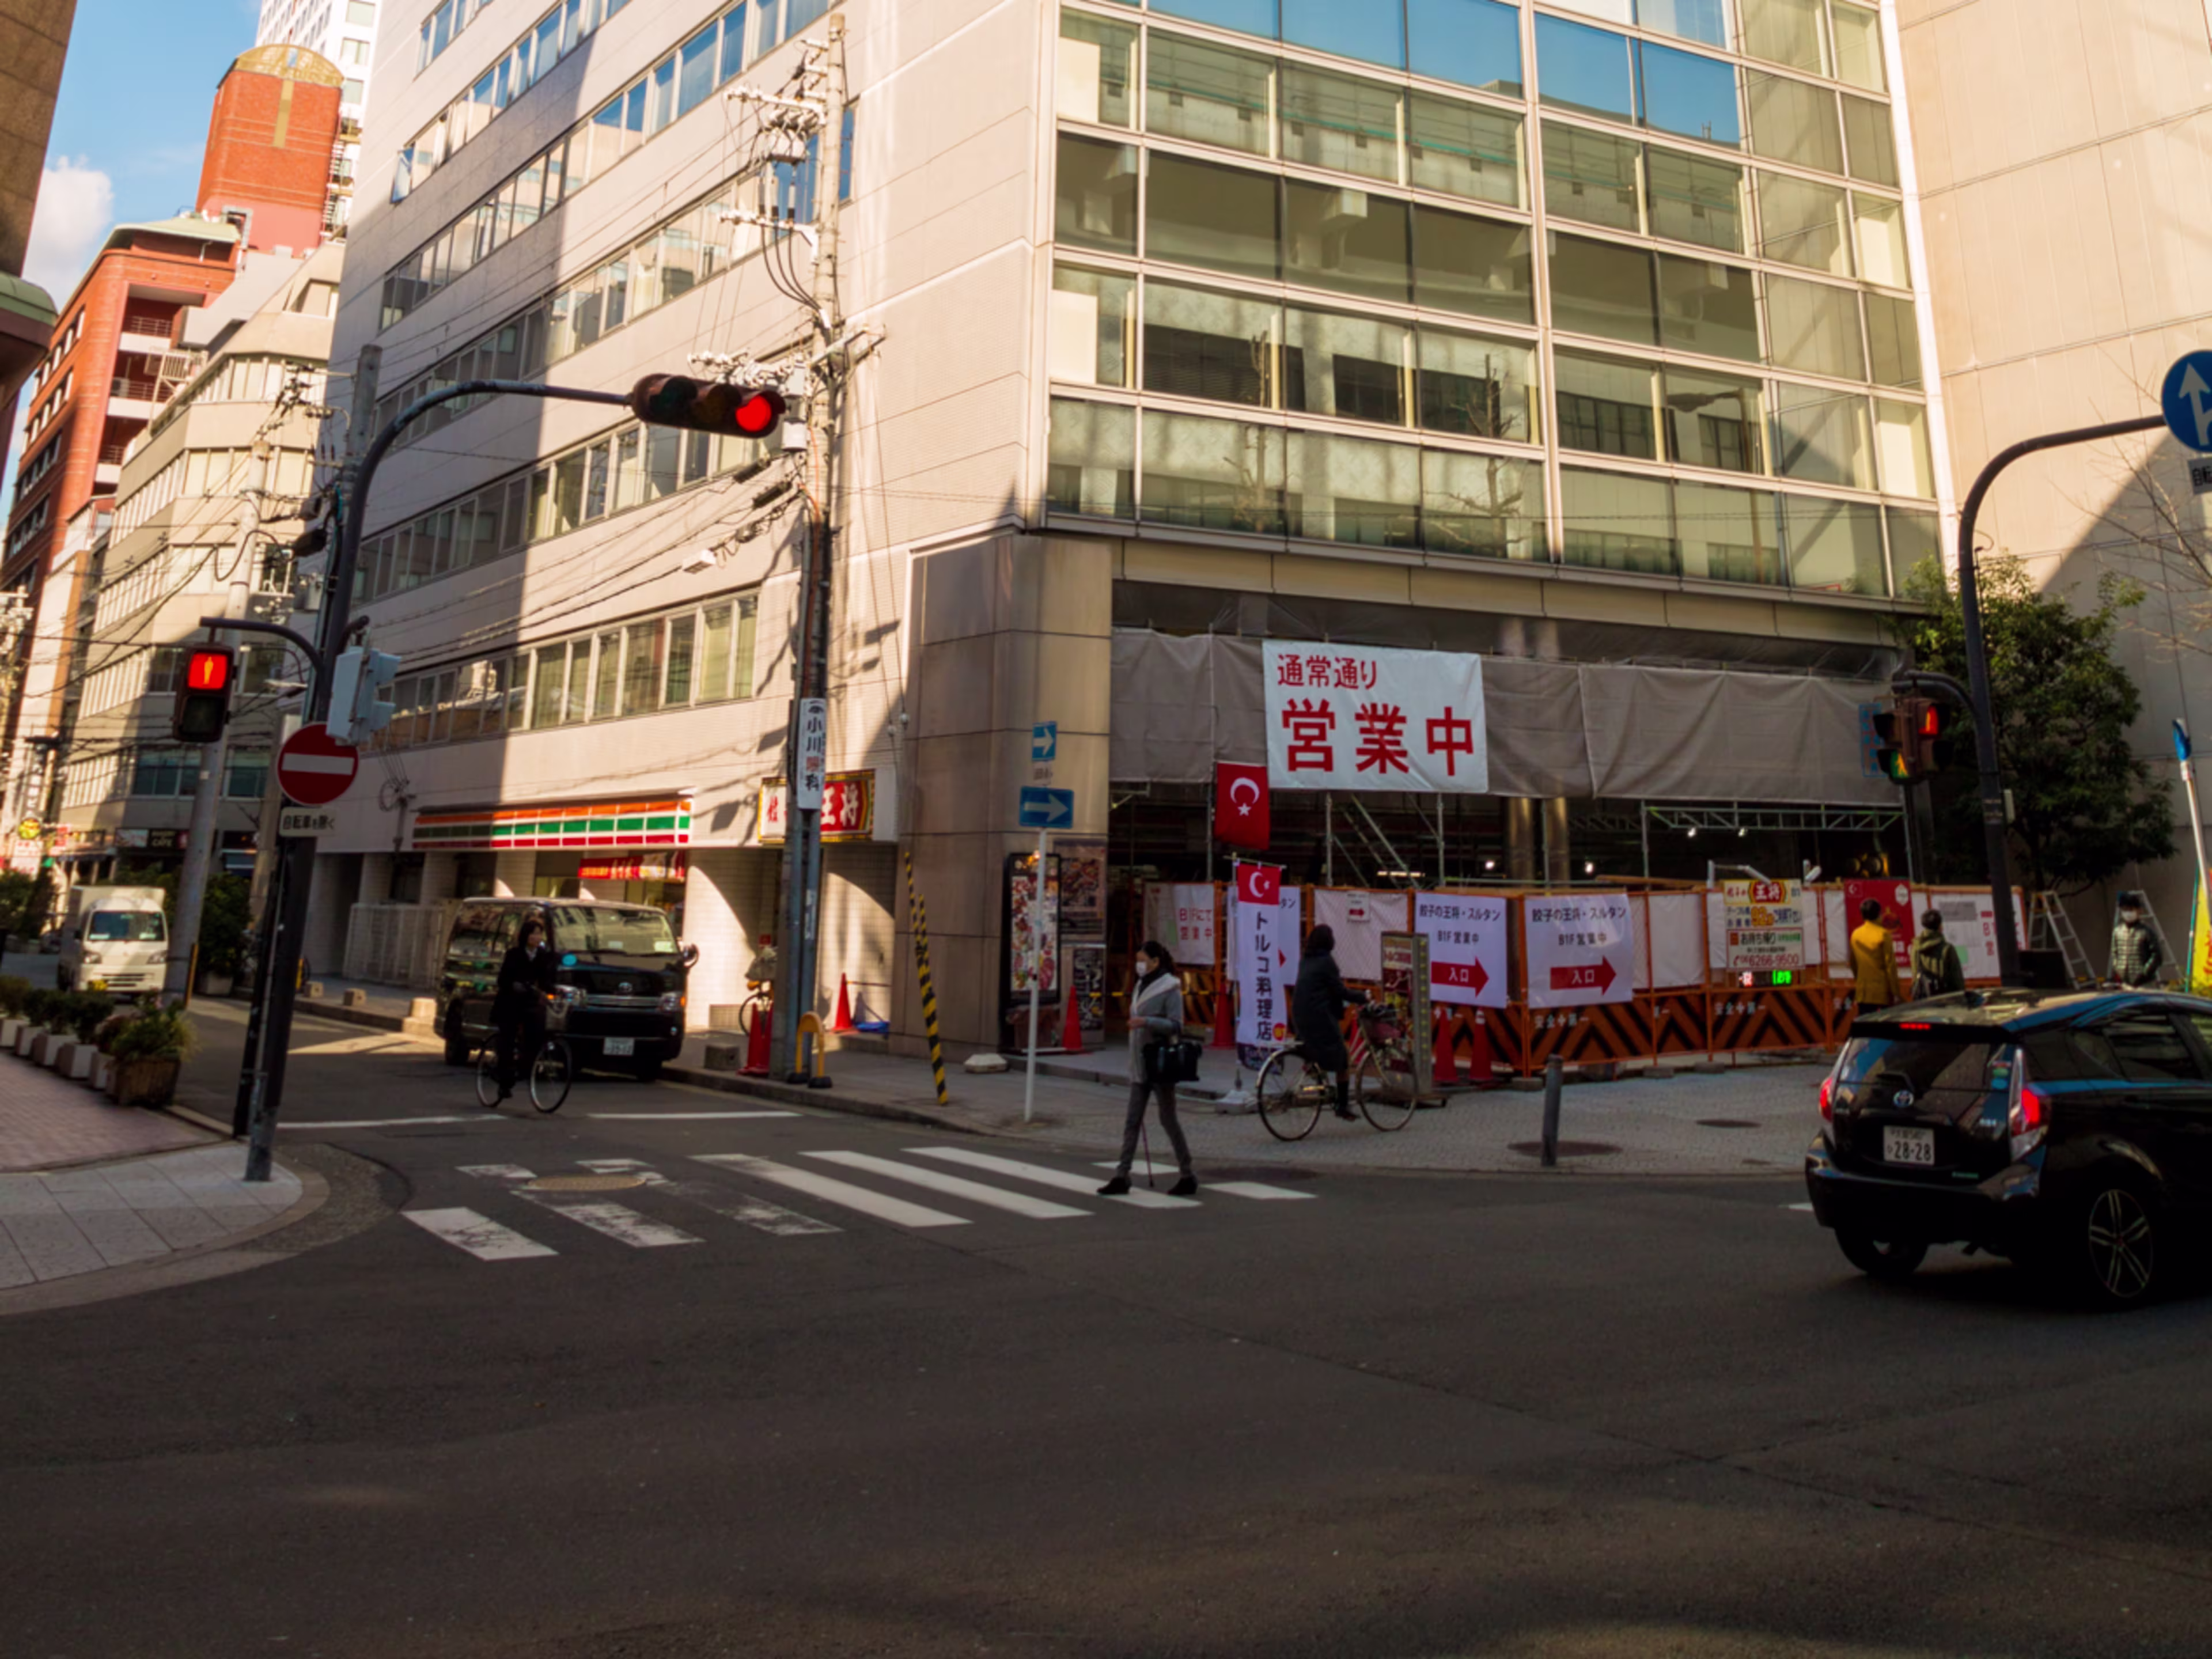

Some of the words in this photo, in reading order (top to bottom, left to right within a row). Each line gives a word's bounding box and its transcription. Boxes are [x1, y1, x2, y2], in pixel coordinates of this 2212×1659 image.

[1278, 654, 1377, 690] 通常通り
[1282, 698, 1475, 777] 営業中
[1255, 911, 1274, 1041] トルコ料理店
[1448, 967, 1469, 983] 入口
[1570, 969, 1595, 984] 入口
